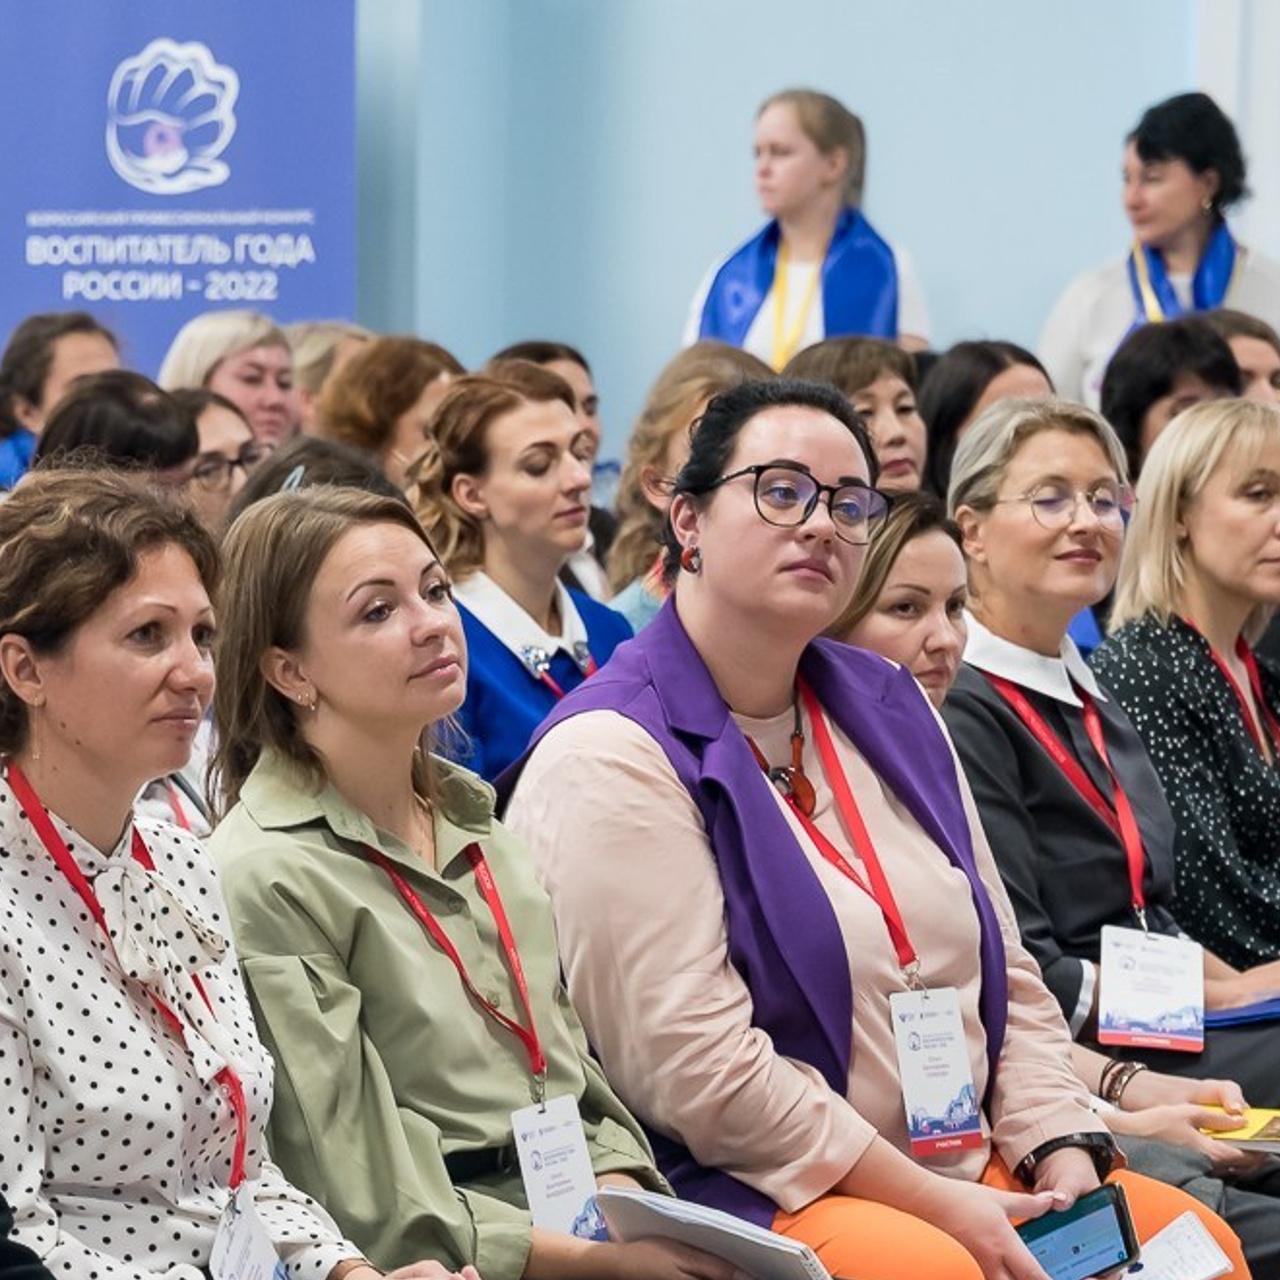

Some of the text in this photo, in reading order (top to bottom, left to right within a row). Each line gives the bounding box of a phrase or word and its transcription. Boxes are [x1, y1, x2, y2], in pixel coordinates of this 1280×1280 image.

[26, 233, 316, 268] ВОСПИТАТЕЛЬ ГОДА
[63, 270, 182, 300] РОССИИ
[205, 270, 278, 300] 2022
